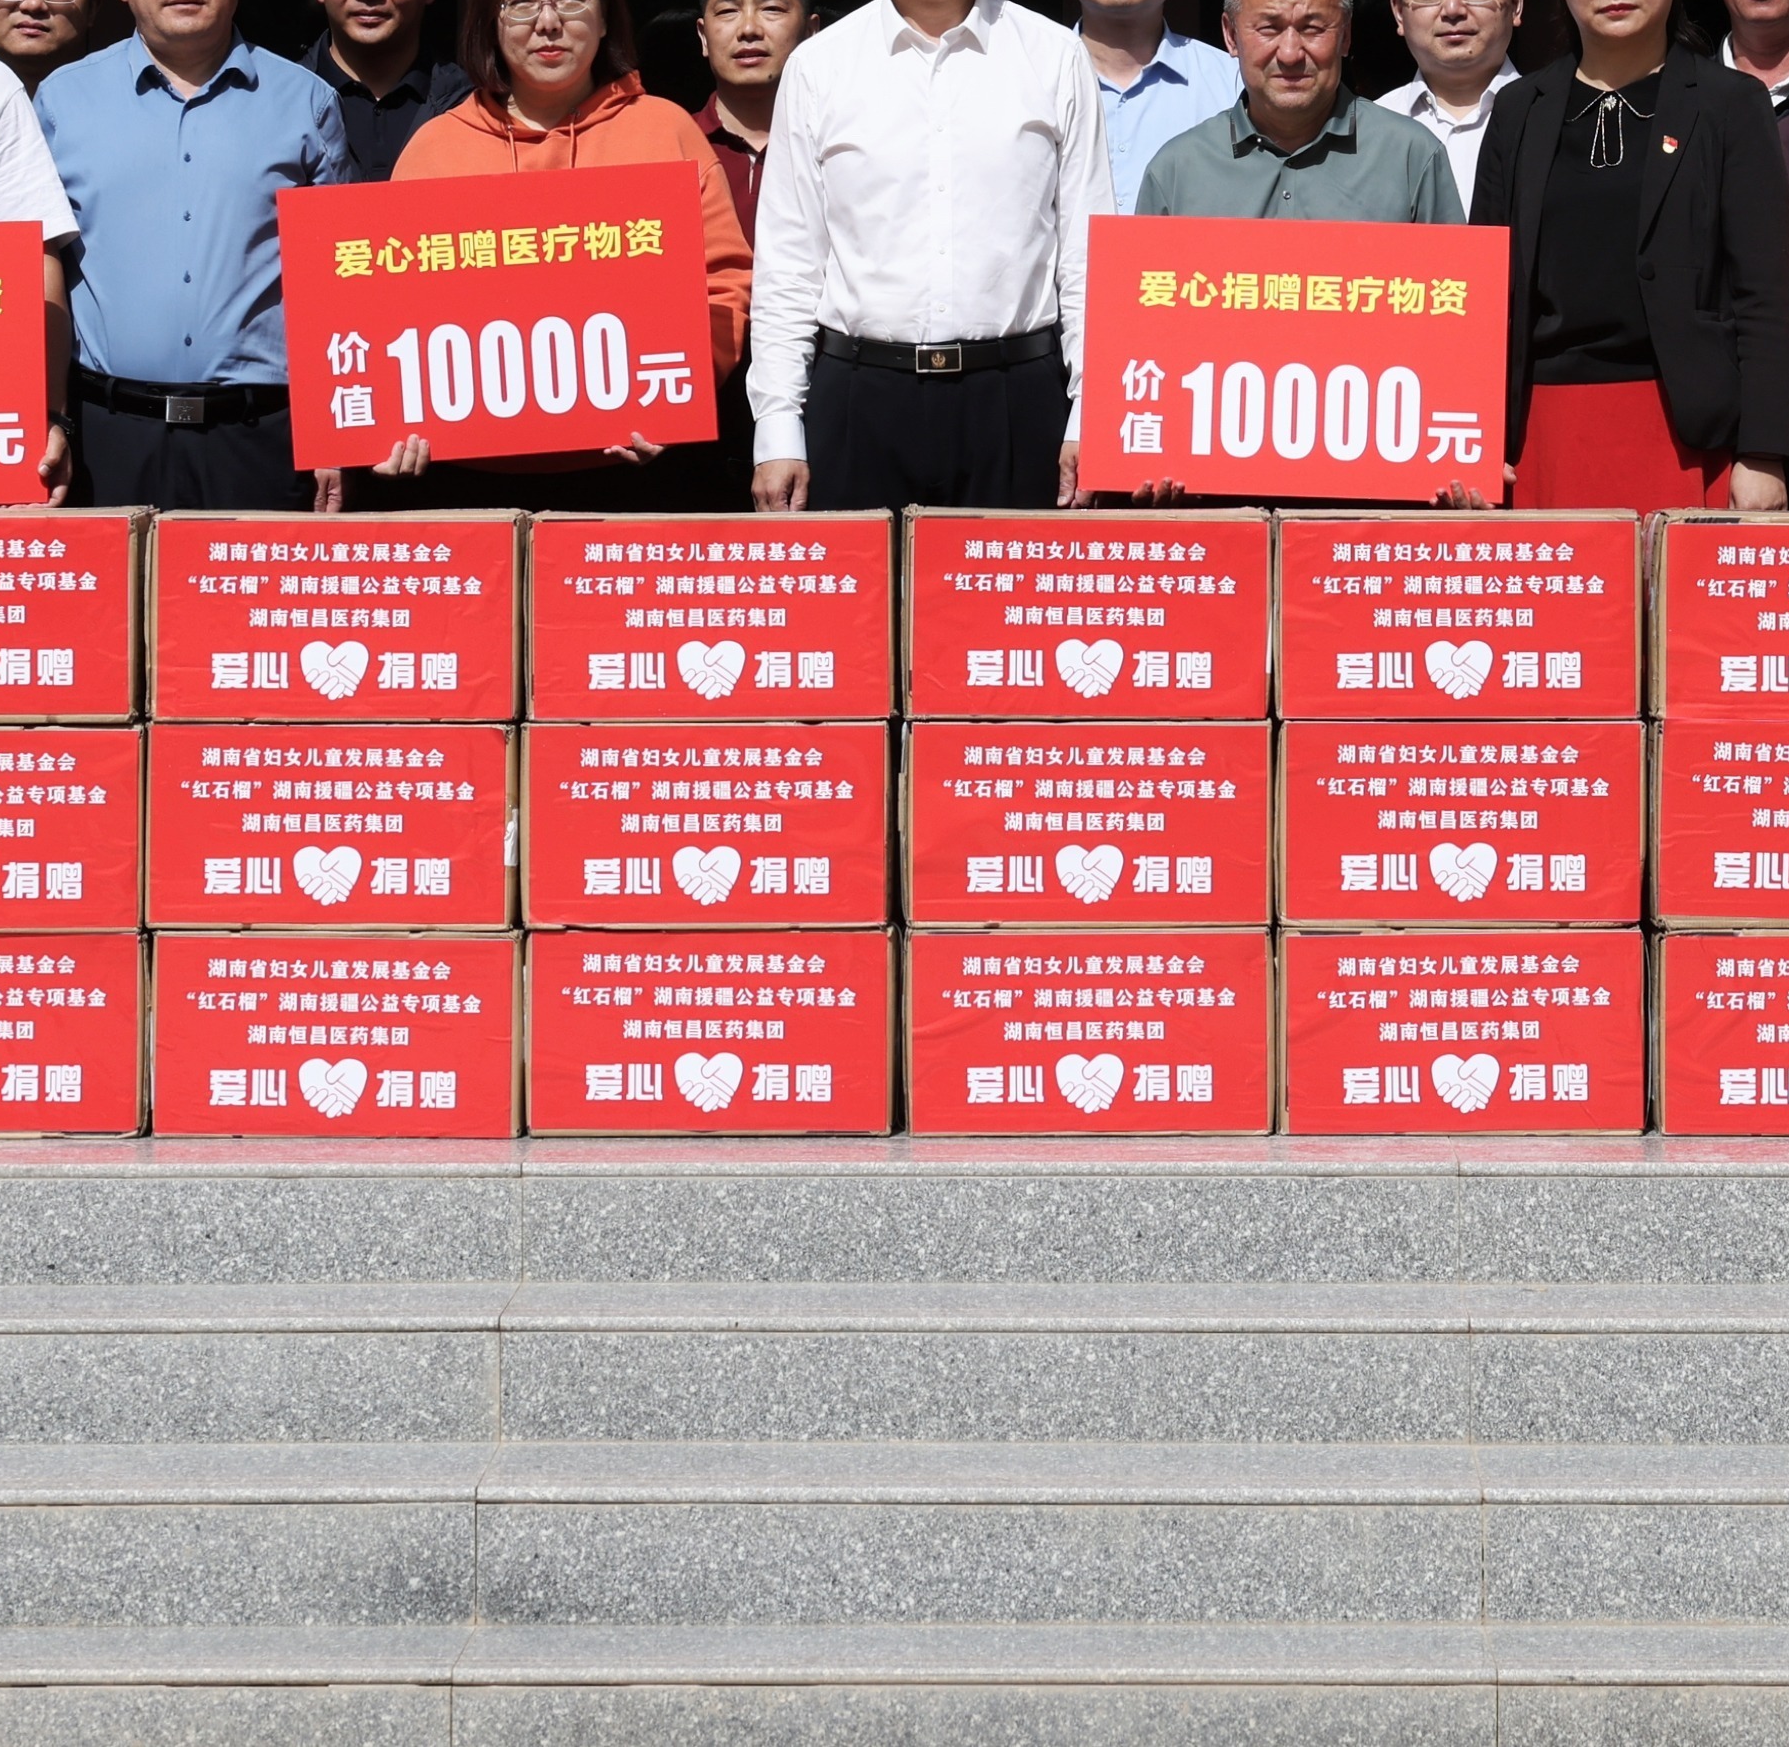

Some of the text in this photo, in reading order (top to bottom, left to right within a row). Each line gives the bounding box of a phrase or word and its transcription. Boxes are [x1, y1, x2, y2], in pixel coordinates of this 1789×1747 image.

[335, 219, 664, 278] 爱心捐赠医疗物资
[1139, 271, 1468, 316] 爱心捐赠医疗物资
[584, 542, 827, 563] 湖南省妇女儿童发展基金会
[1332, 542, 1574, 562] 湖南省妇女儿童发展基金会
[625, 607, 786, 628] 湖南恒昌医药集团
[1373, 607, 1533, 628] 湖南恒昌医药集团
[588, 650, 834, 690] 爱心 捐赠
[1336, 651, 1581, 689] 爱心 捐赠
[201, 747, 445, 768] 湖南省妇女儿童发展基金会
[964, 746, 1206, 766] 湖南省妇女儿童发展基金会
[241, 813, 403, 833] 湖南恒昌医药集团
[1004, 811, 1165, 832] 湖南恒昌医药集团
[204, 857, 451, 896] 爱心 捐赠
[966, 855, 1212, 894] 爱心 捐赠
[582, 953, 826, 974] 湖南省妇女儿童发展基金会
[1337, 954, 1580, 977] 湖南省妇女儿童发展基金会
[622, 1019, 784, 1040] 湖南恒昌医药集团
[1379, 1020, 1540, 1042] 湖南恒昌医药集团
[0, 1063, 82, 1103] 捐赠
[585, 1063, 832, 1102] 爱心 捐赠
[1342, 1063, 1588, 1105] 爱心 捐赠
